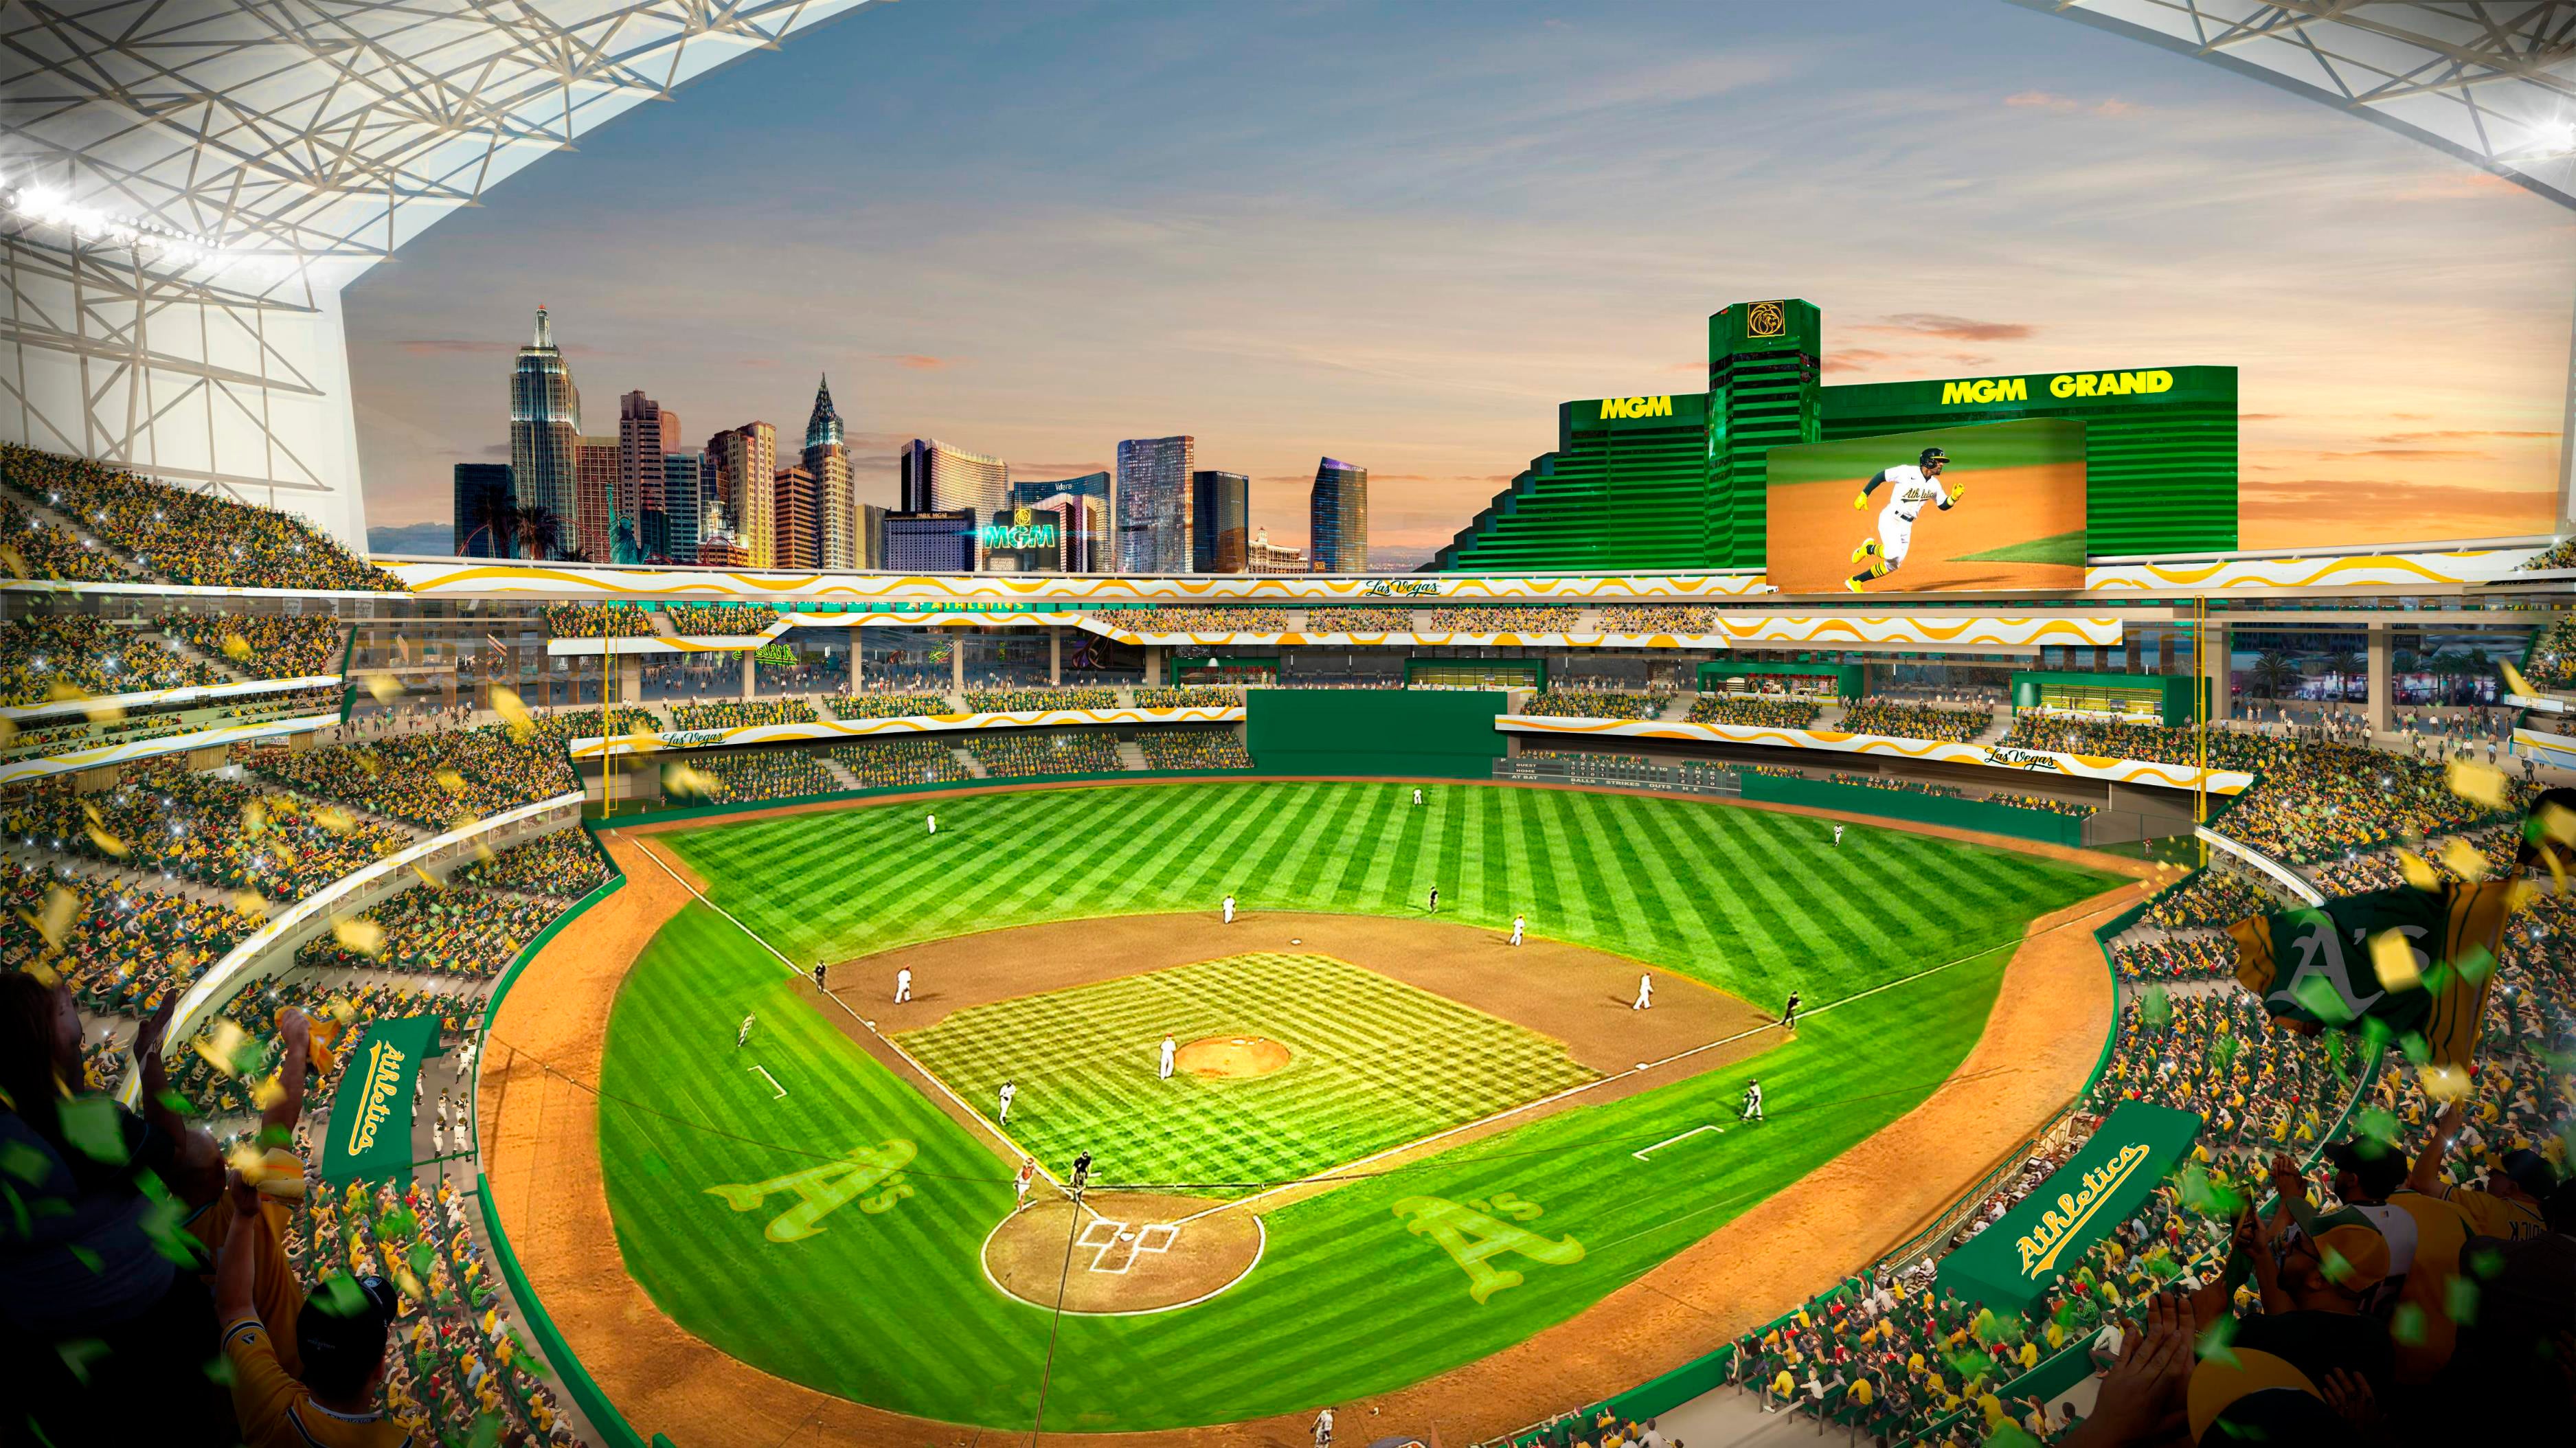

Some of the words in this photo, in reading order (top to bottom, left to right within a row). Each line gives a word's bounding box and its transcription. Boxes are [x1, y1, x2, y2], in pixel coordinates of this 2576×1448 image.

[1941, 378, 2028, 405] MGM
[2050, 370, 2173, 398] GRAND
[1600, 396, 1673, 419] MGM
[984, 524, 1055, 549] MGM
[1366, 578, 1392, 596] Las
[1390, 579, 1441, 597] Vegas
[662, 733, 685, 749] Las
[684, 732, 725, 747] Vegas
[1985, 747, 2010, 765] Las
[2008, 749, 2058, 771] Vegas
[348, 1039, 405, 1155] Athletics
[703, 1139, 918, 1243] A's
[2015, 1144, 2149, 1280] Athletics
[1392, 1192, 1585, 1304] A's
